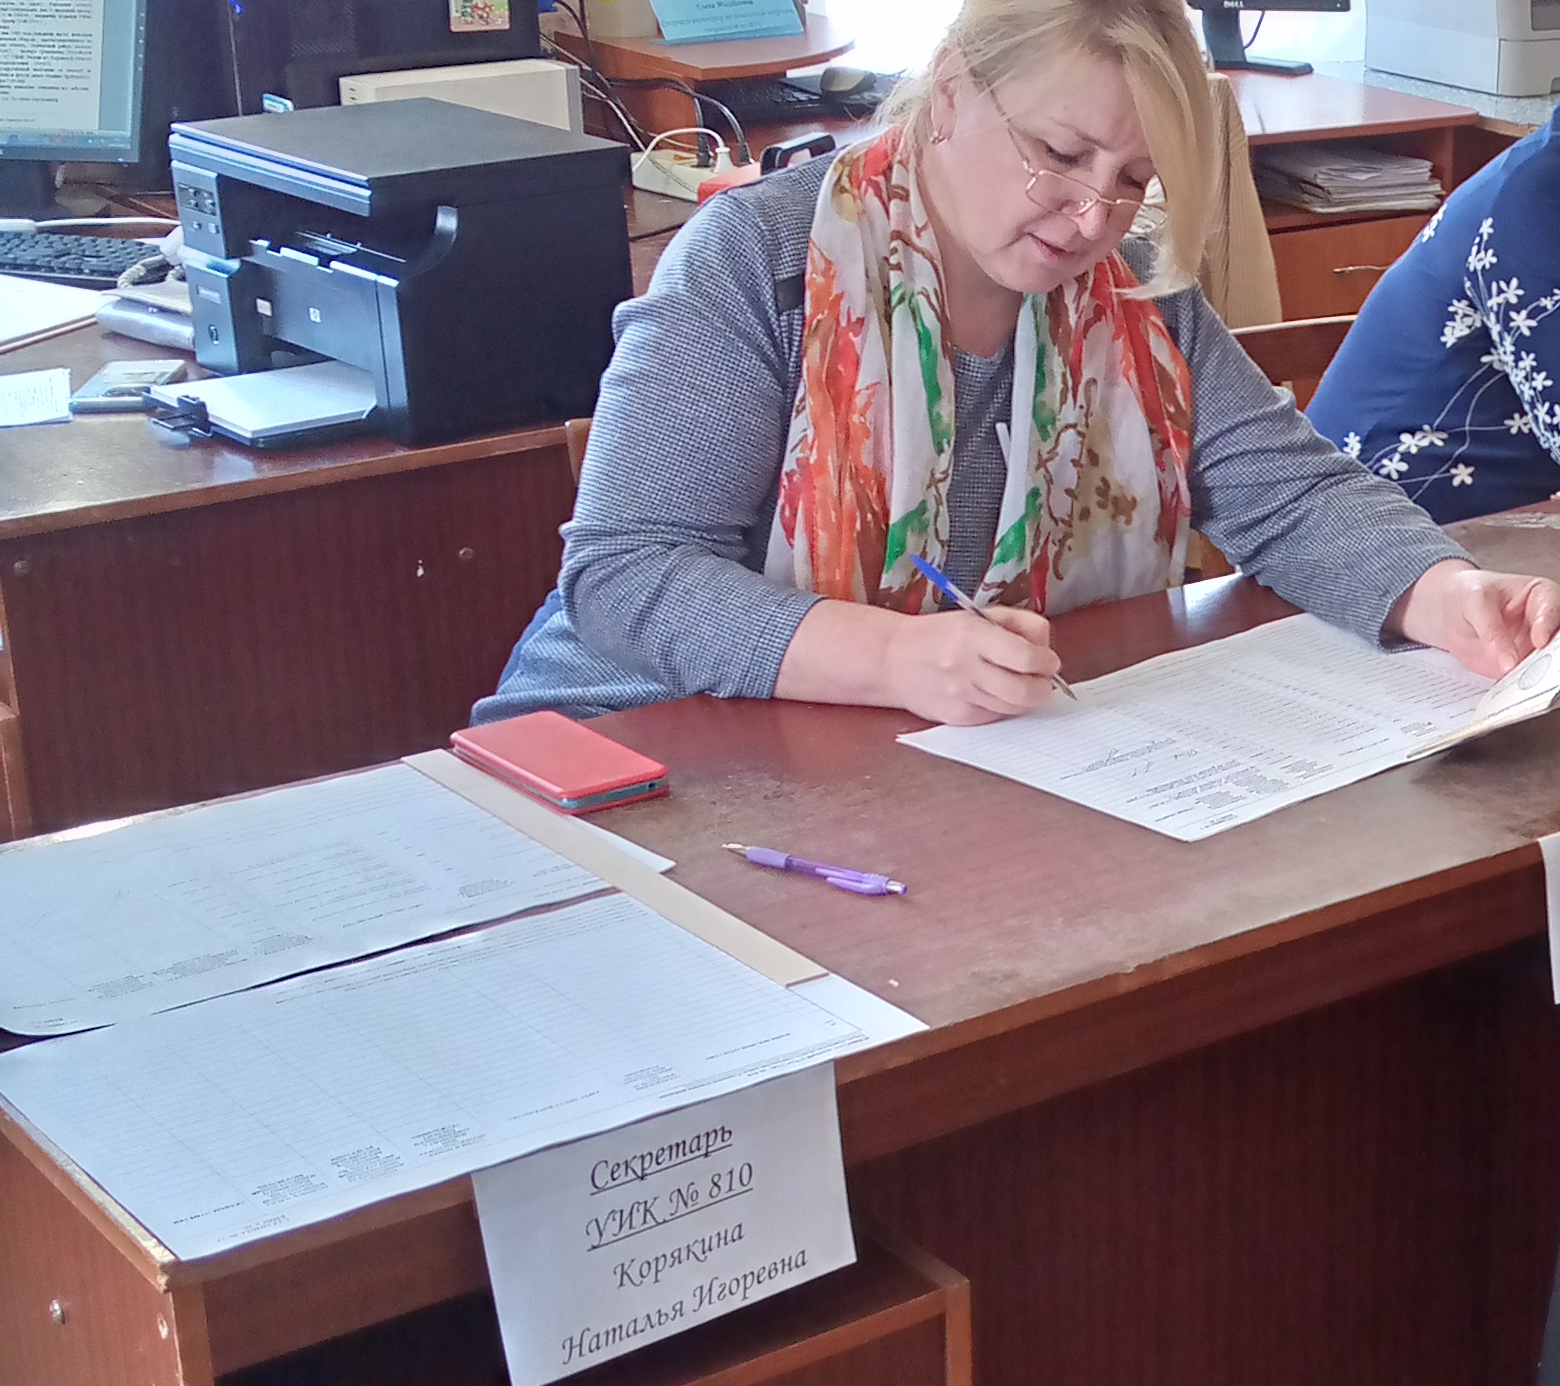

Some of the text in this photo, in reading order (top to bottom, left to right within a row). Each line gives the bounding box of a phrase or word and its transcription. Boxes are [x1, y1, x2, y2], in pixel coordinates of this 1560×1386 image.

[590, 1124, 733, 1193] Секретарь
[585, 1162, 753, 1250] УИК № 810
[613, 1222, 745, 1289] Корякина
[562, 1248, 808, 1365] Наталья Игоревна
